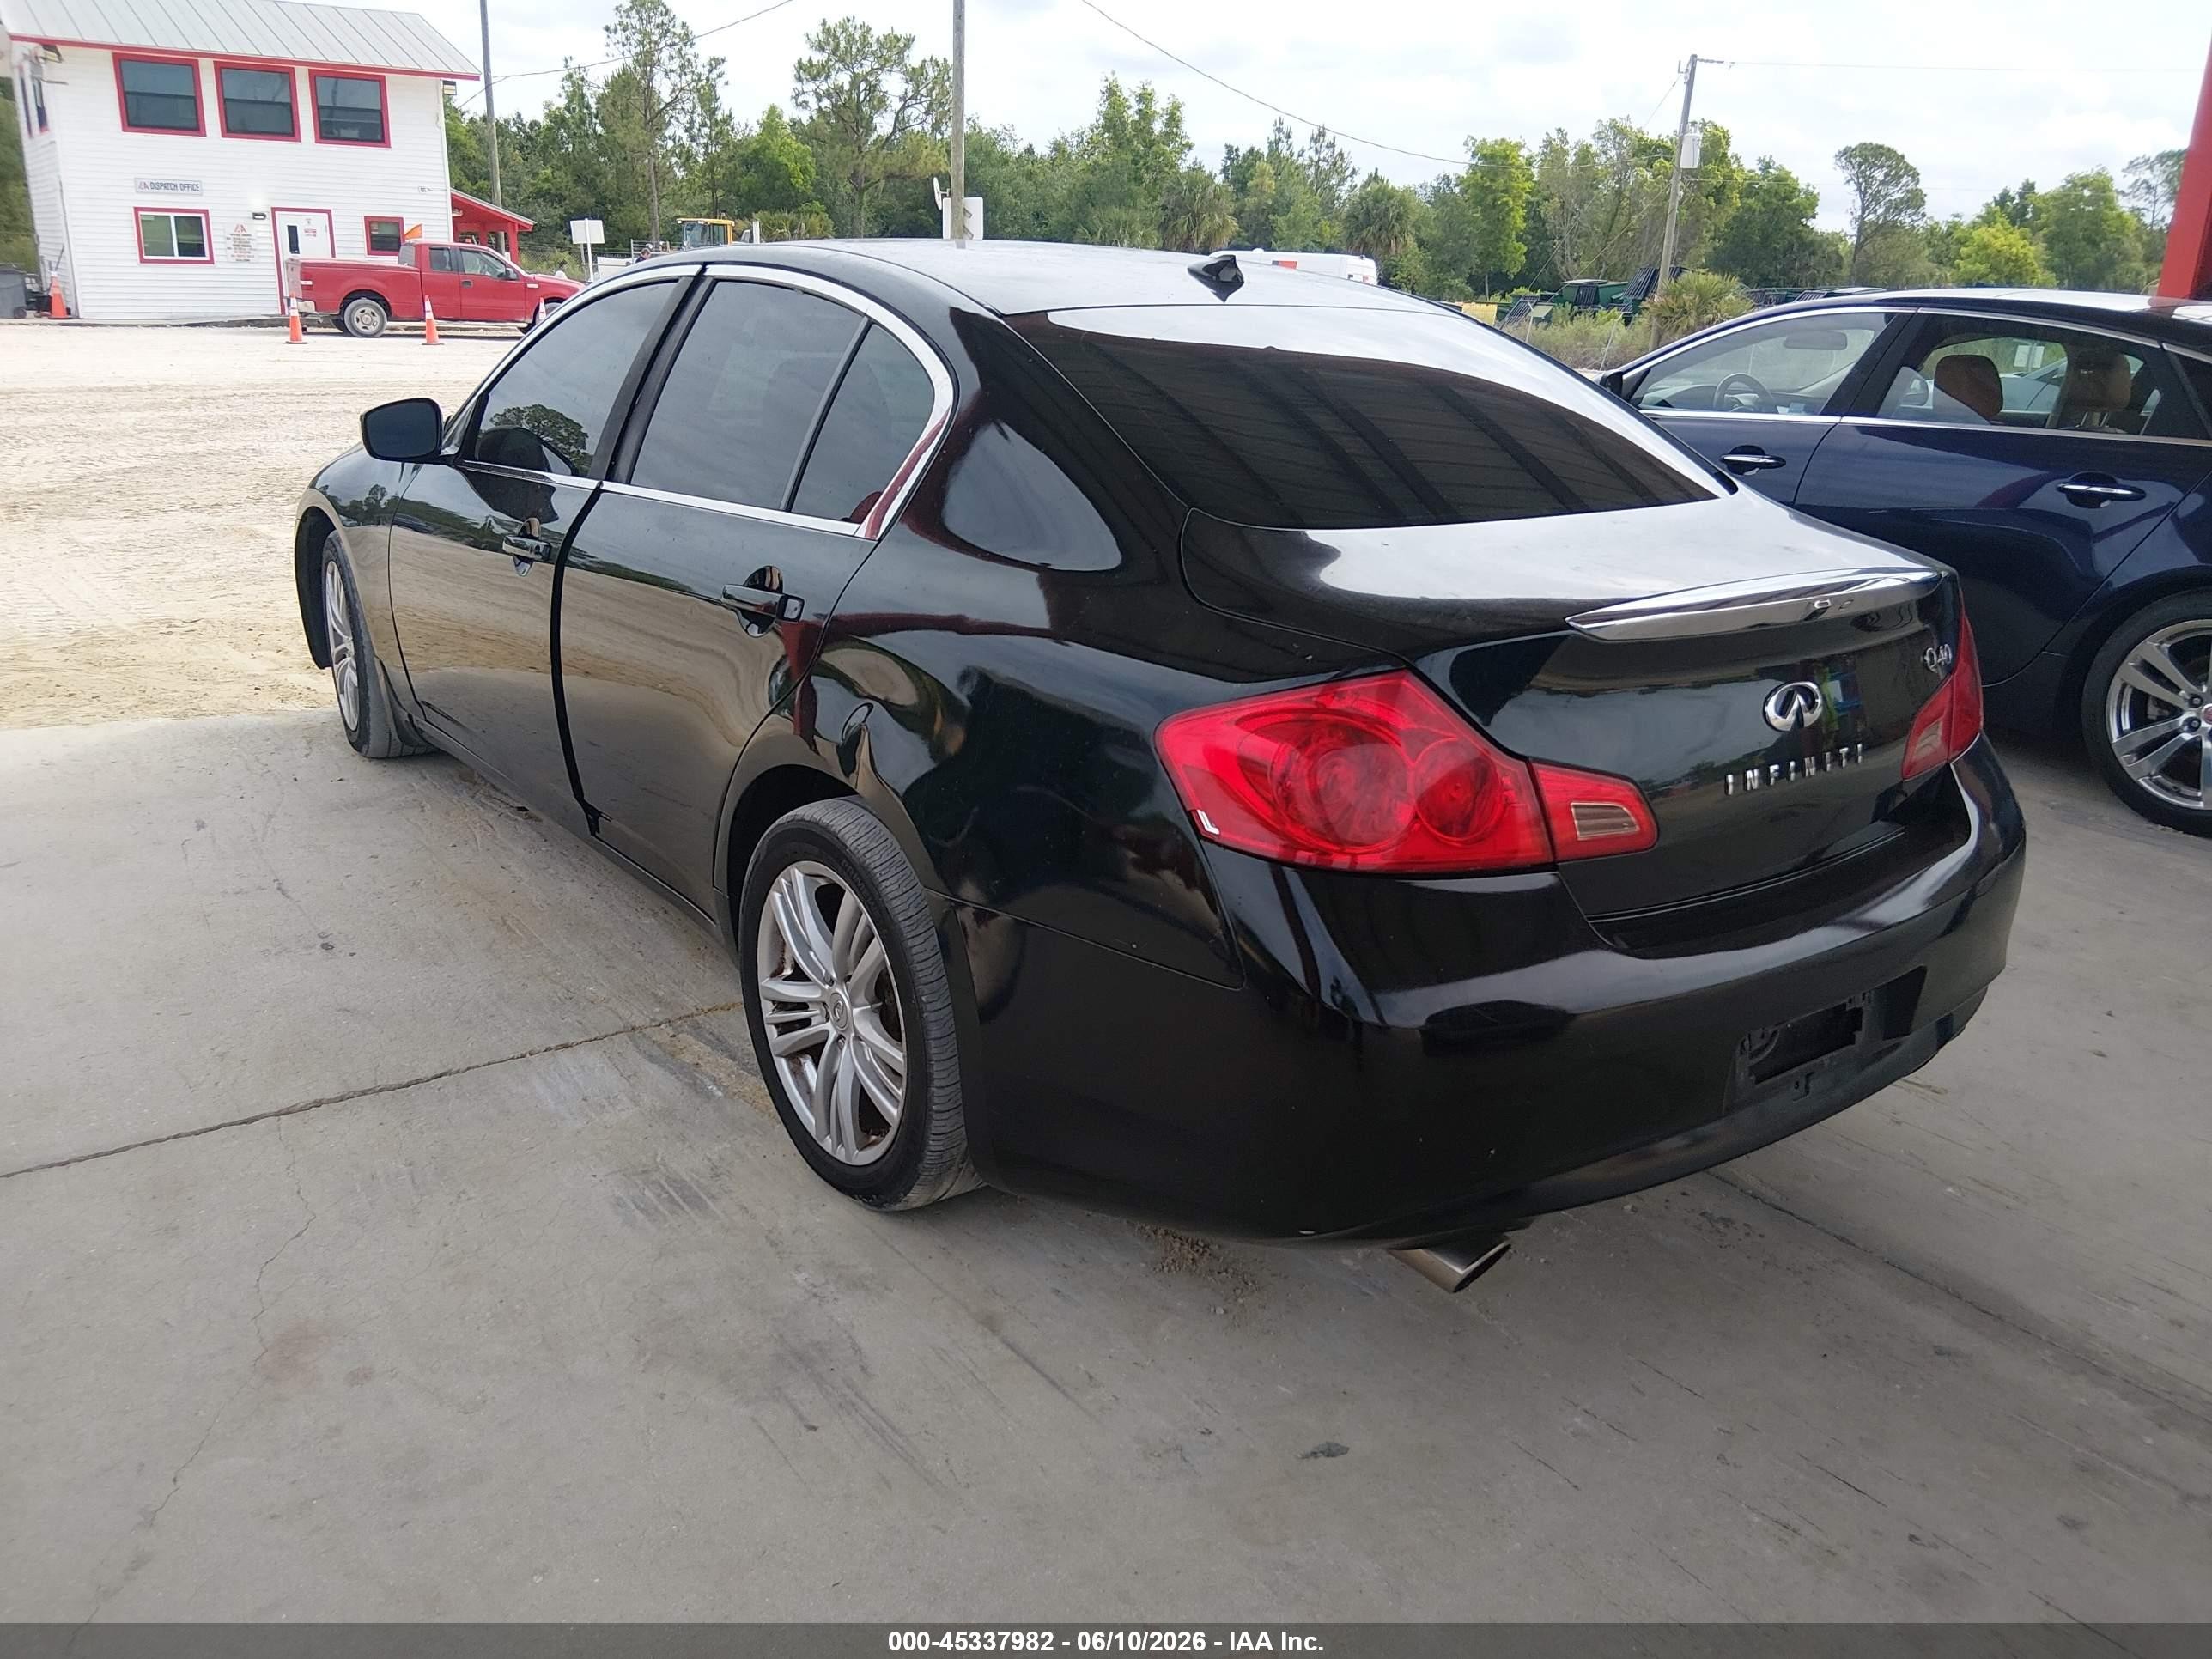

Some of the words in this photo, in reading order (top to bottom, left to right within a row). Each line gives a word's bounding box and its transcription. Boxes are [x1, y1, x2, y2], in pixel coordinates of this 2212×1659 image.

[150, 181, 178, 191] DISPATCH
[179, 183, 200, 191] OFFICE
[1923, 644, 1953, 674] Q40
[1726, 743, 1863, 796] INFINITI
